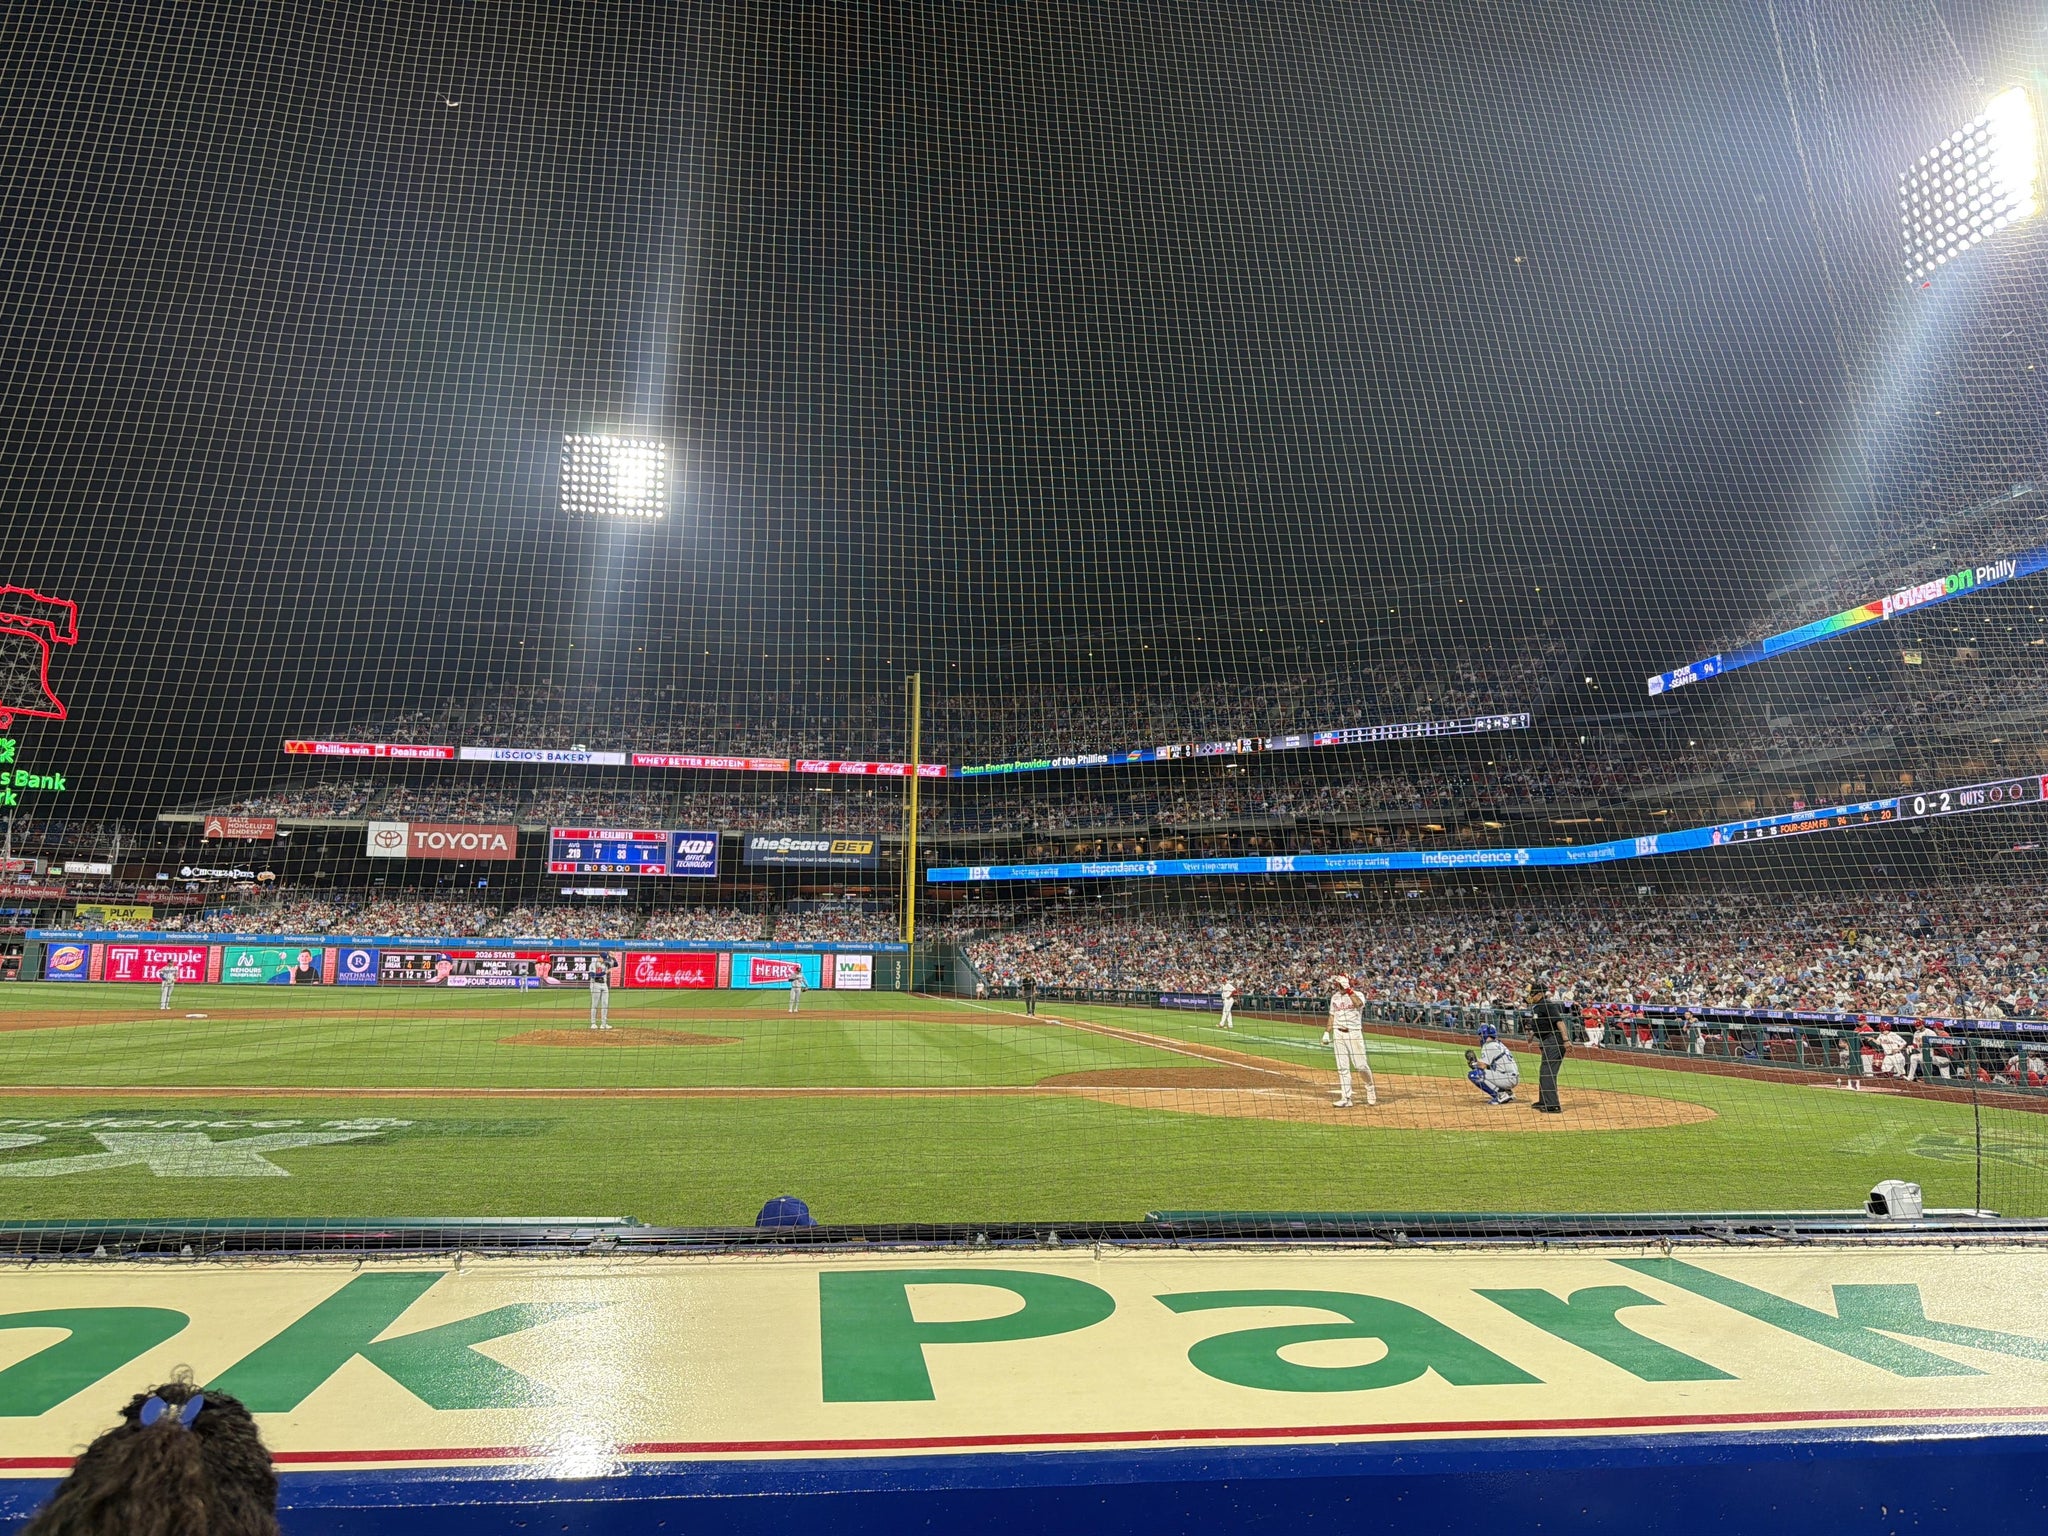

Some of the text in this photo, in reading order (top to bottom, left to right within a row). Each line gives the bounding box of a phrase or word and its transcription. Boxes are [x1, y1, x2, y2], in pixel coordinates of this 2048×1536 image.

[1976, 559, 2016, 584] Philly
[1673, 666, 1690, 678] FOUR
[1704, 663, 1714, 673] 94
[1689, 673, 1697, 682] FB
[1478, 720, 1484, 728] R
[316, 745, 445, 758] Phillies win Deals roll in
[495, 751, 592, 762] LISCIO'S BAKERY
[637, 756, 668, 764] WHEY
[669, 757, 702, 766] BETTER
[705, 758, 745, 767] PROTEIN
[961, 753, 1108, 775] Clean Energy Provider of the Phillies
[15, 770, 66, 790] Bank
[1959, 790, 1985, 806] OUTS
[228, 822, 273, 830] MONGELUZZI
[1780, 820, 1819, 834] FOUR-SEAM
[1819, 819, 1828, 828] FB
[1837, 816, 1847, 825] 94
[1881, 810, 1891, 820] 20
[415, 832, 508, 851] TOYOTA
[751, 837, 869, 852] theScore BET
[1635, 835, 1658, 856] IBX
[595, 849, 601, 859] 7
[1422, 850, 1510, 867] Independence
[1082, 863, 1145, 875] Independence
[1266, 856, 1295, 871] IBX
[969, 866, 990, 880] IBX
[15, 887, 58, 896] Budweiser
[159, 893, 198, 901] Budweiser
[110, 908, 136, 917] PLAY
[143, 949, 202, 963] Temple
[354, 957, 363, 965] R
[422, 961, 431, 969] 20
[840, 963, 868, 971] WM
[635, 961, 705, 983] Chick-fil-A
[467, 977, 507, 985] FOUR-SEAM
[507, 978, 516, 986] FB
[820, 1257, 2048, 1402] Park
